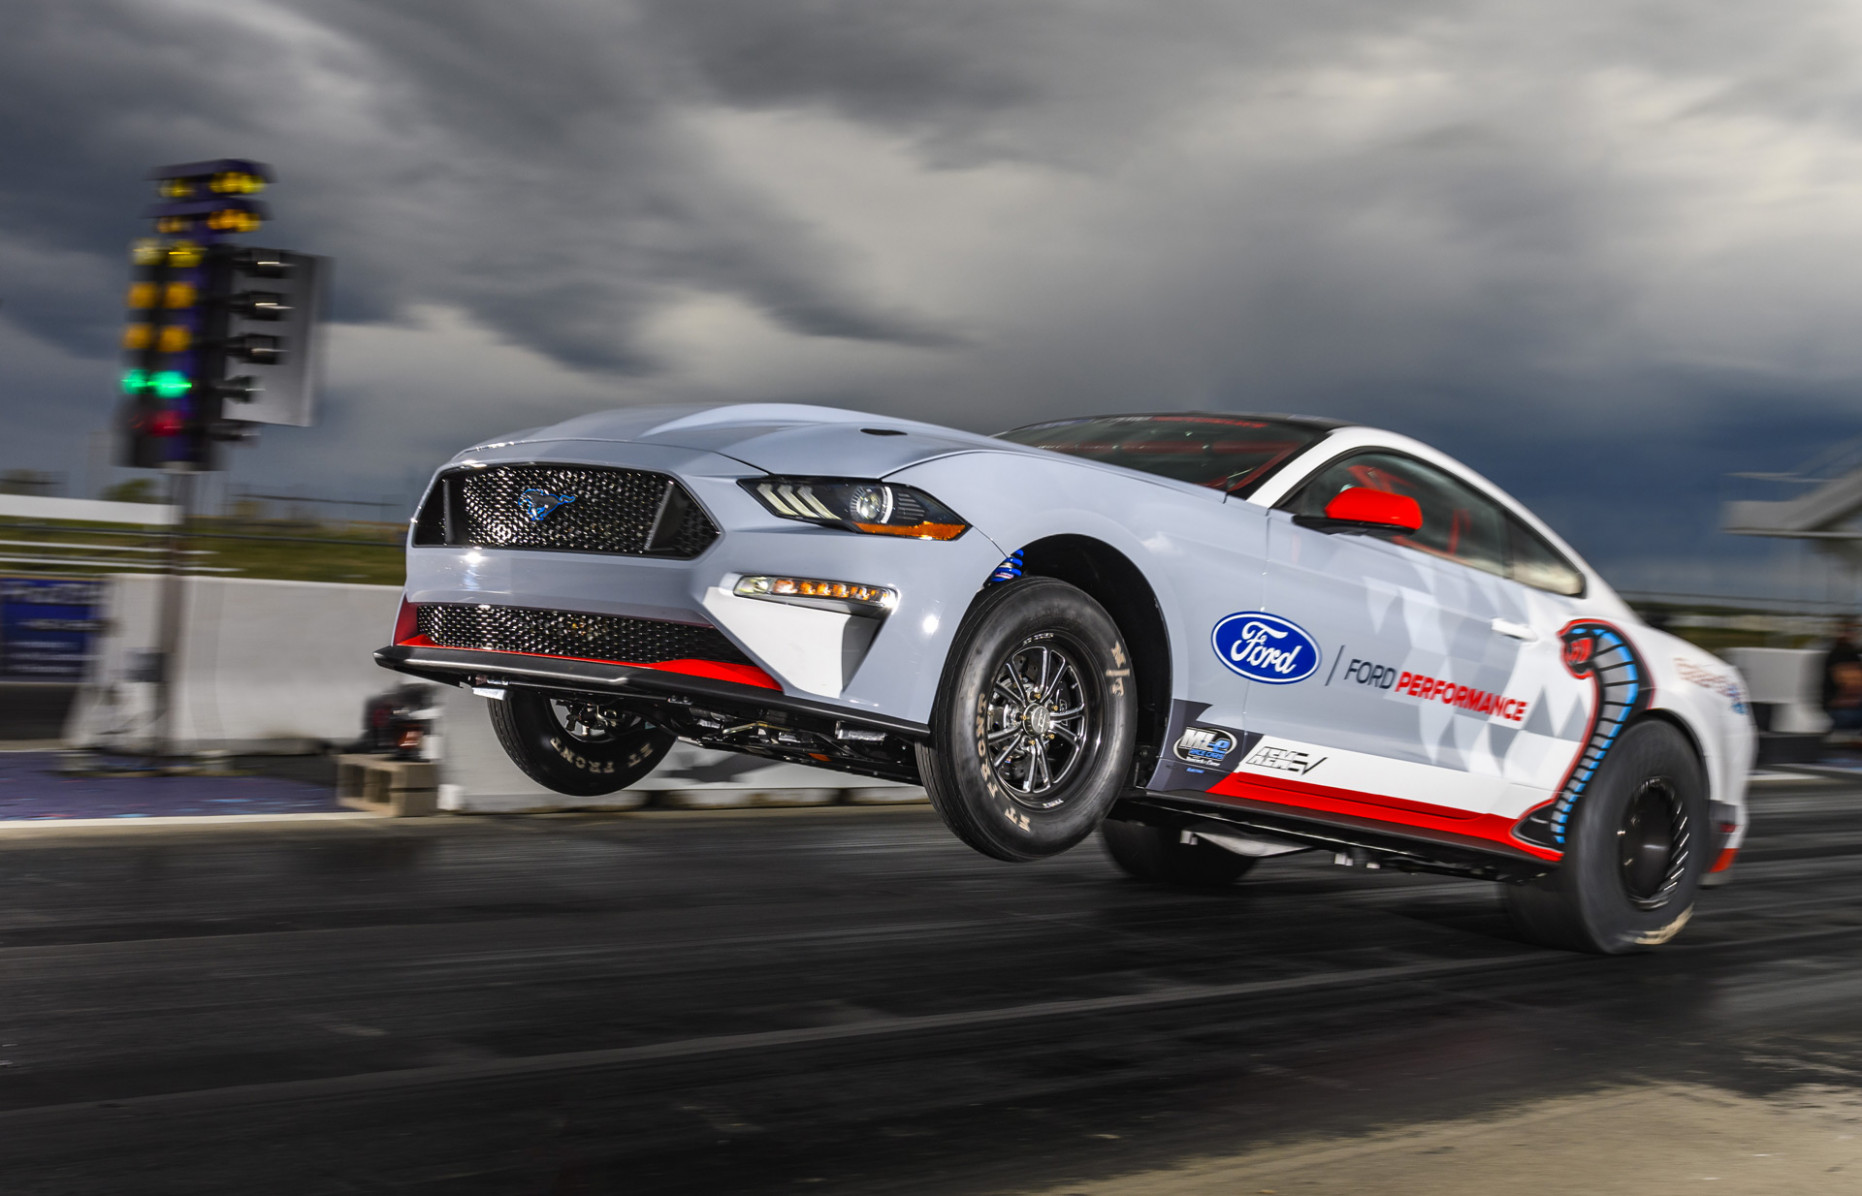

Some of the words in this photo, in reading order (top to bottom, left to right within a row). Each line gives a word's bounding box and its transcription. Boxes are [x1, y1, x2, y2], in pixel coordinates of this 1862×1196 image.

[1230, 620, 1303, 675] Ford
[1344, 658, 1397, 690] FORD
[1395, 671, 1527, 722] PERFORMANCE
